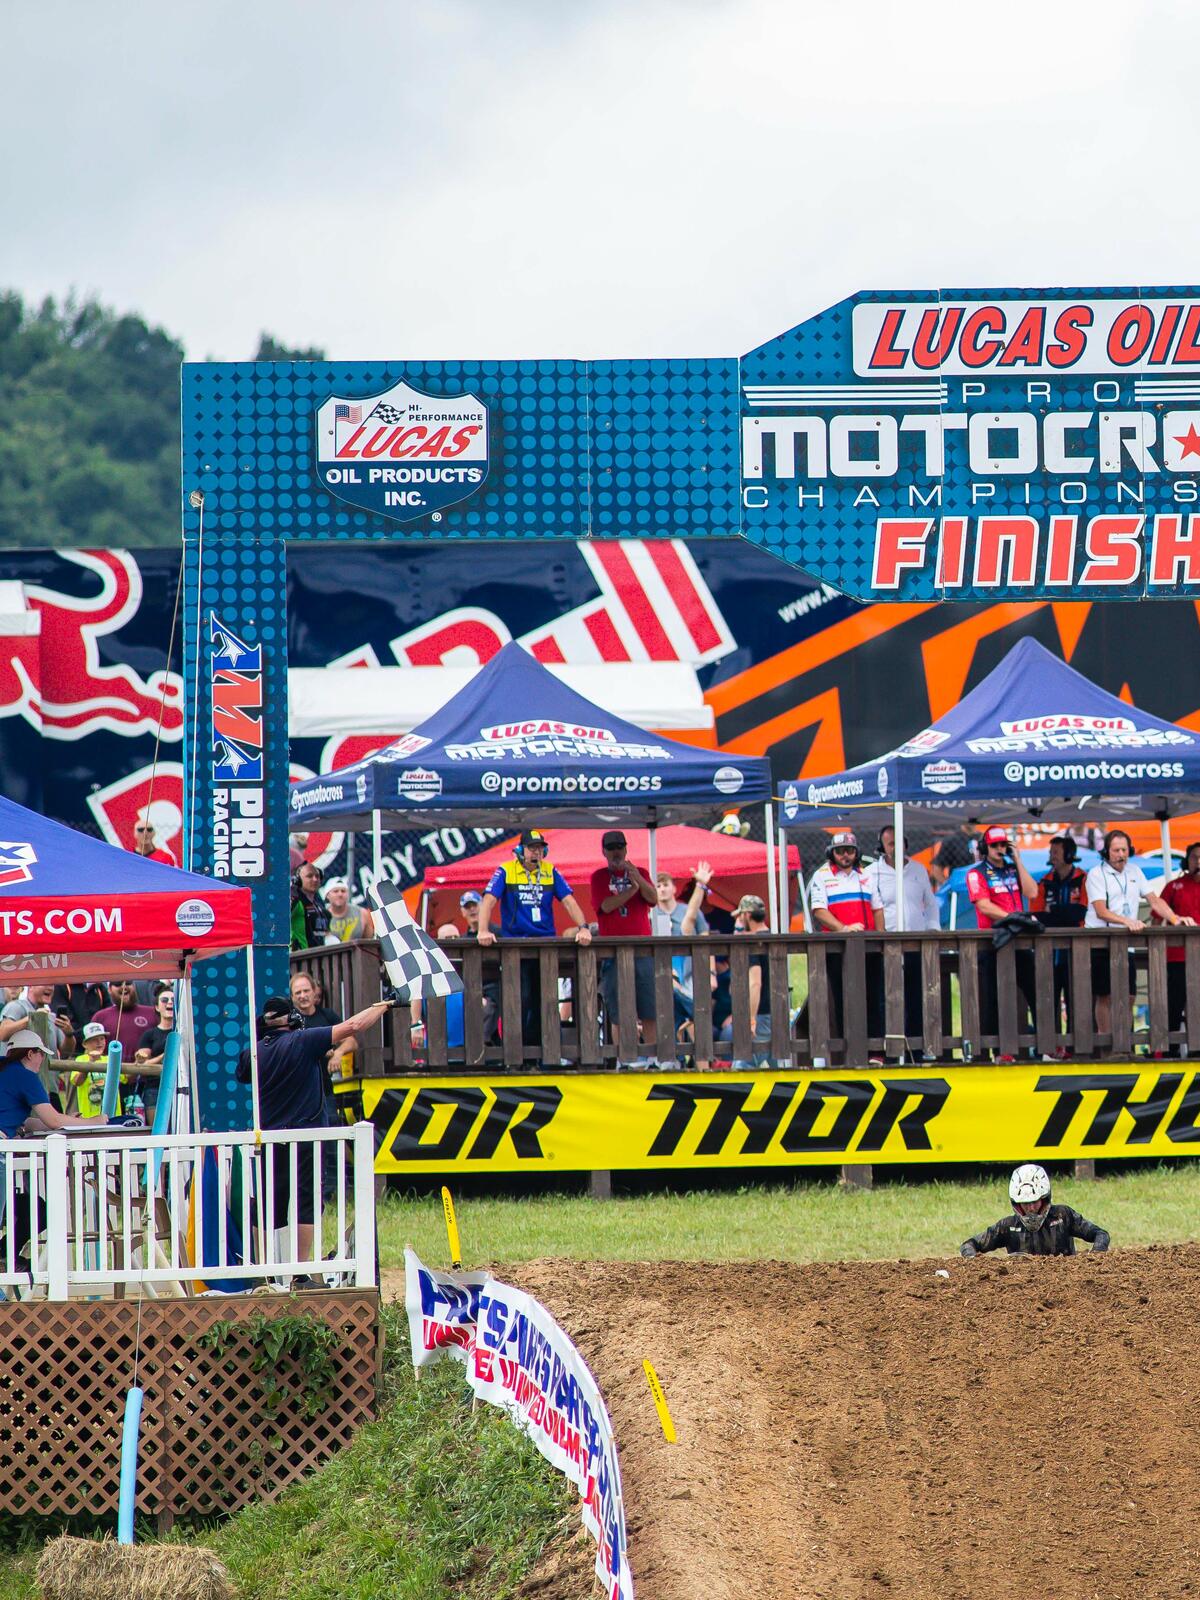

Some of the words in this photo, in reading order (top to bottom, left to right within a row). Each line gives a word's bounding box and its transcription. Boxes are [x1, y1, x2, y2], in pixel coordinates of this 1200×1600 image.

[868, 304, 1094, 369] LUCAS
[962, 380, 1121, 403] PRO
[408, 404, 423, 412] HI-
[408, 413, 483, 422] PERFORMANCE
[336, 425, 480, 459] LUCAS
[326, 468, 362, 484] OIL
[369, 467, 482, 484] PRODUCTS
[384, 491, 427, 507] INC.
[490, 721, 566, 740] LUCAS
[572, 726, 610, 741] OIL
[1011, 717, 1085, 733] LUCAS
[1092, 718, 1130, 731] OIL
[480, 771, 662, 798] @promotocross
[1003, 761, 1185, 787] @promotocross
[290, 784, 344, 815] @promotocross
[808, 779, 864, 809] @promotocross
[212, 787, 230, 878] RACING
[231, 787, 265, 877] PRO
[420, 828, 467, 865] TO
[645, 1078, 951, 1157] THOR
